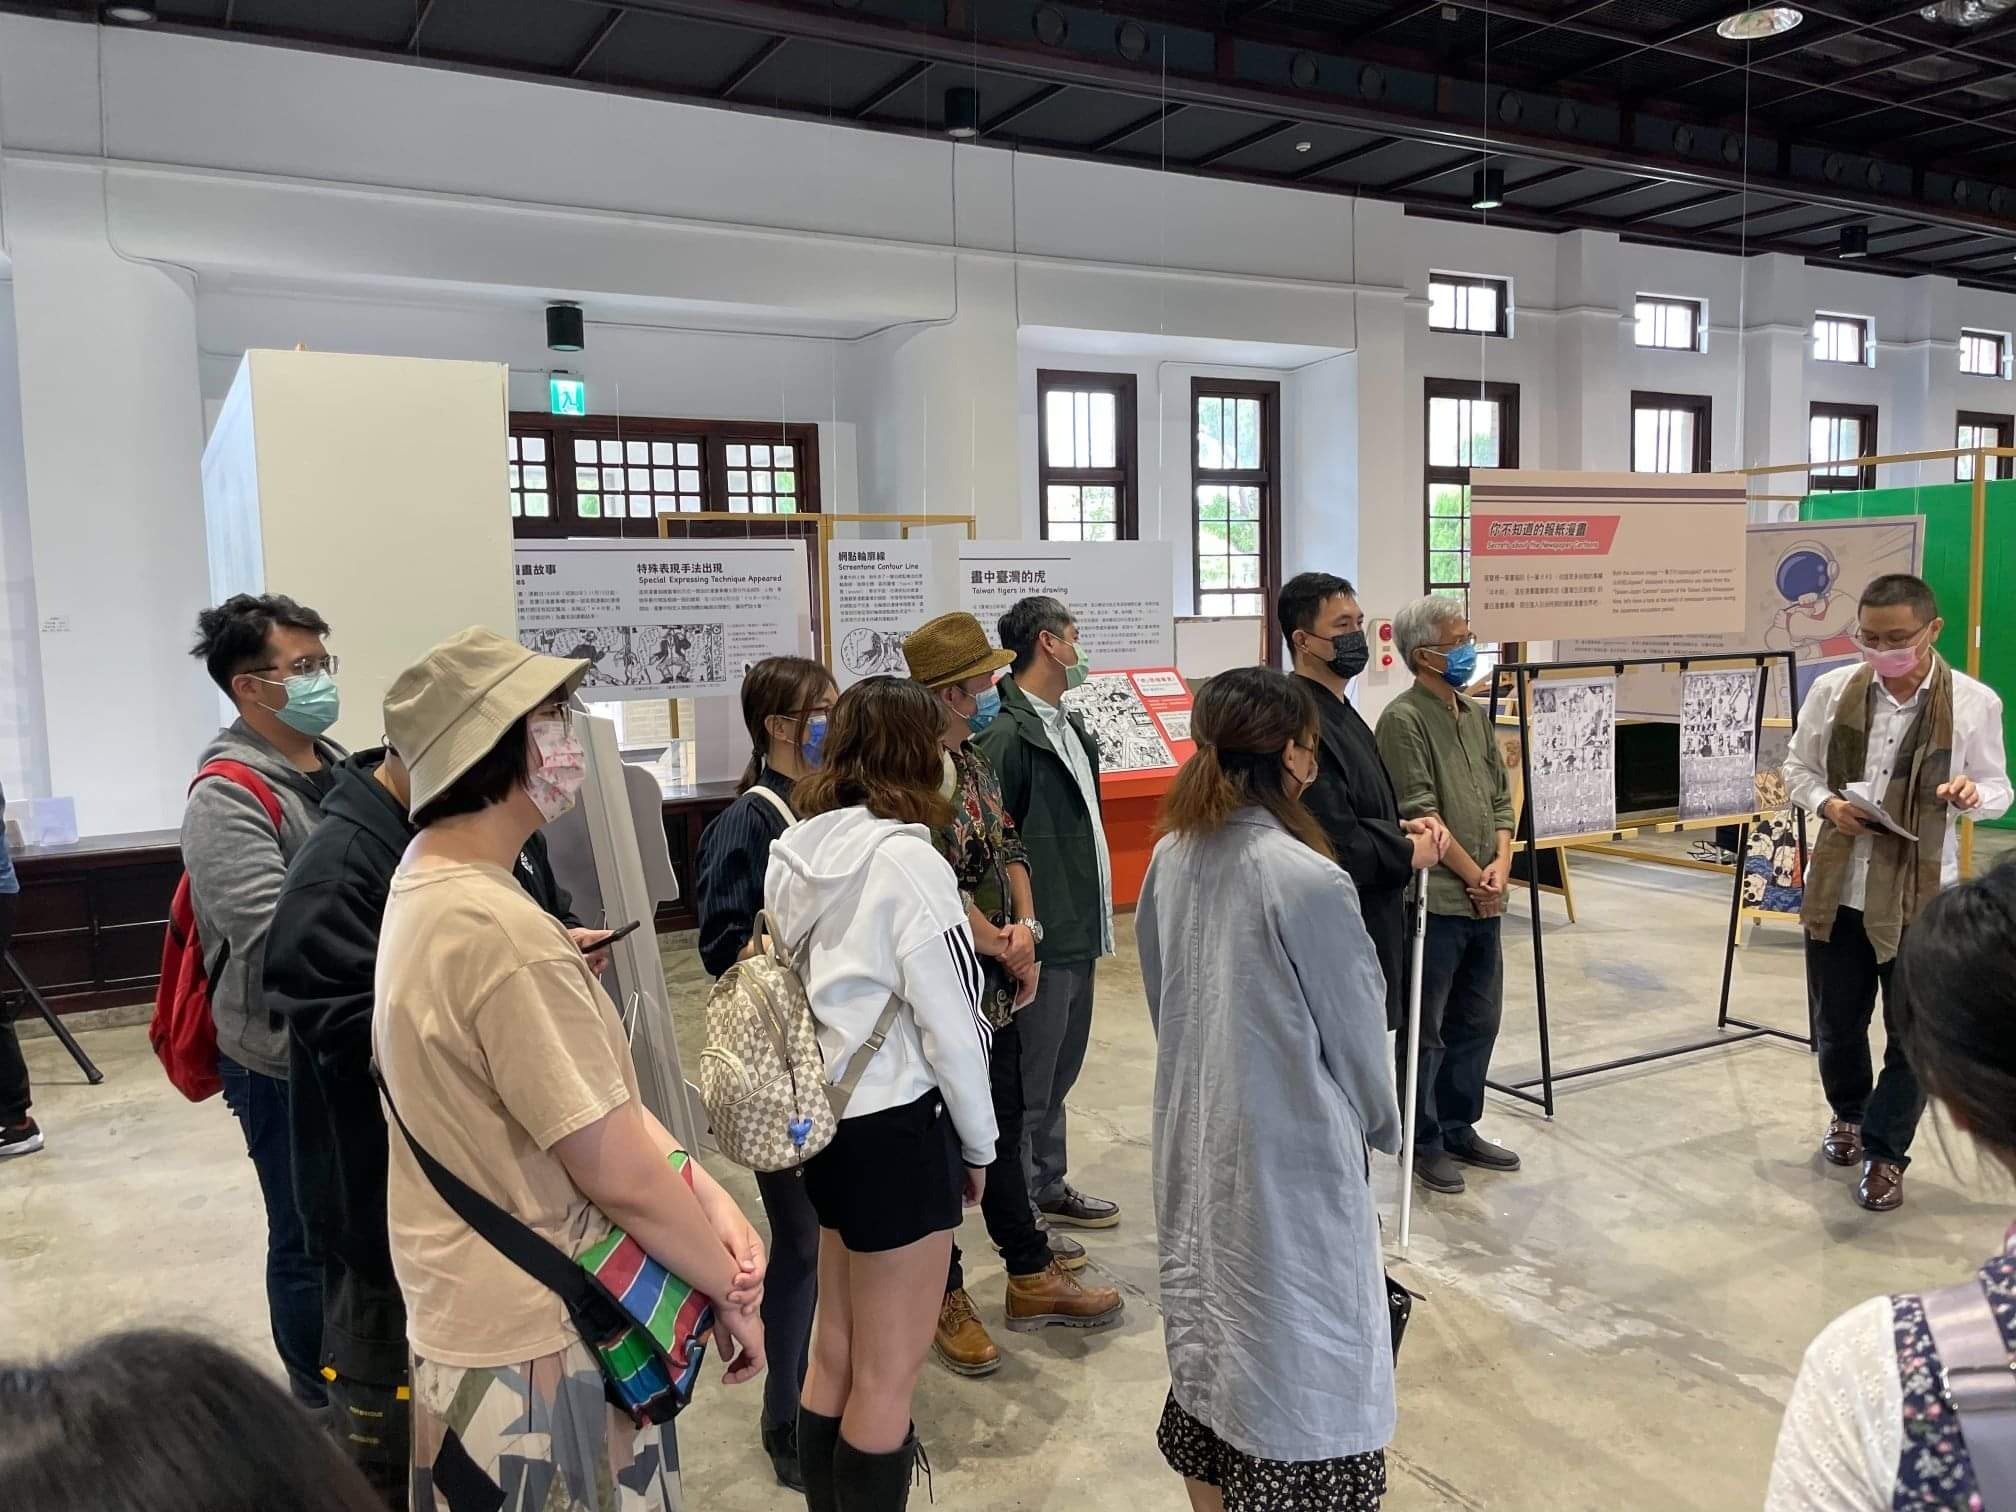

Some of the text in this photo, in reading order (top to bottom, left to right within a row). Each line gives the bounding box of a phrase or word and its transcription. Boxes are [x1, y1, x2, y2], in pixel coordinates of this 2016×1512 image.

[515, 564, 557, 576] 畫故事
[637, 563, 723, 574] 特殊表現手法出現
[838, 563, 875, 571] Screentone
[639, 574, 782, 585] Special Expressing Technique Appeared
[971, 570, 1046, 584] 畫中臺灣的虎
[998, 587, 1017, 595] tigers
[1042, 586, 1069, 595] drawing
